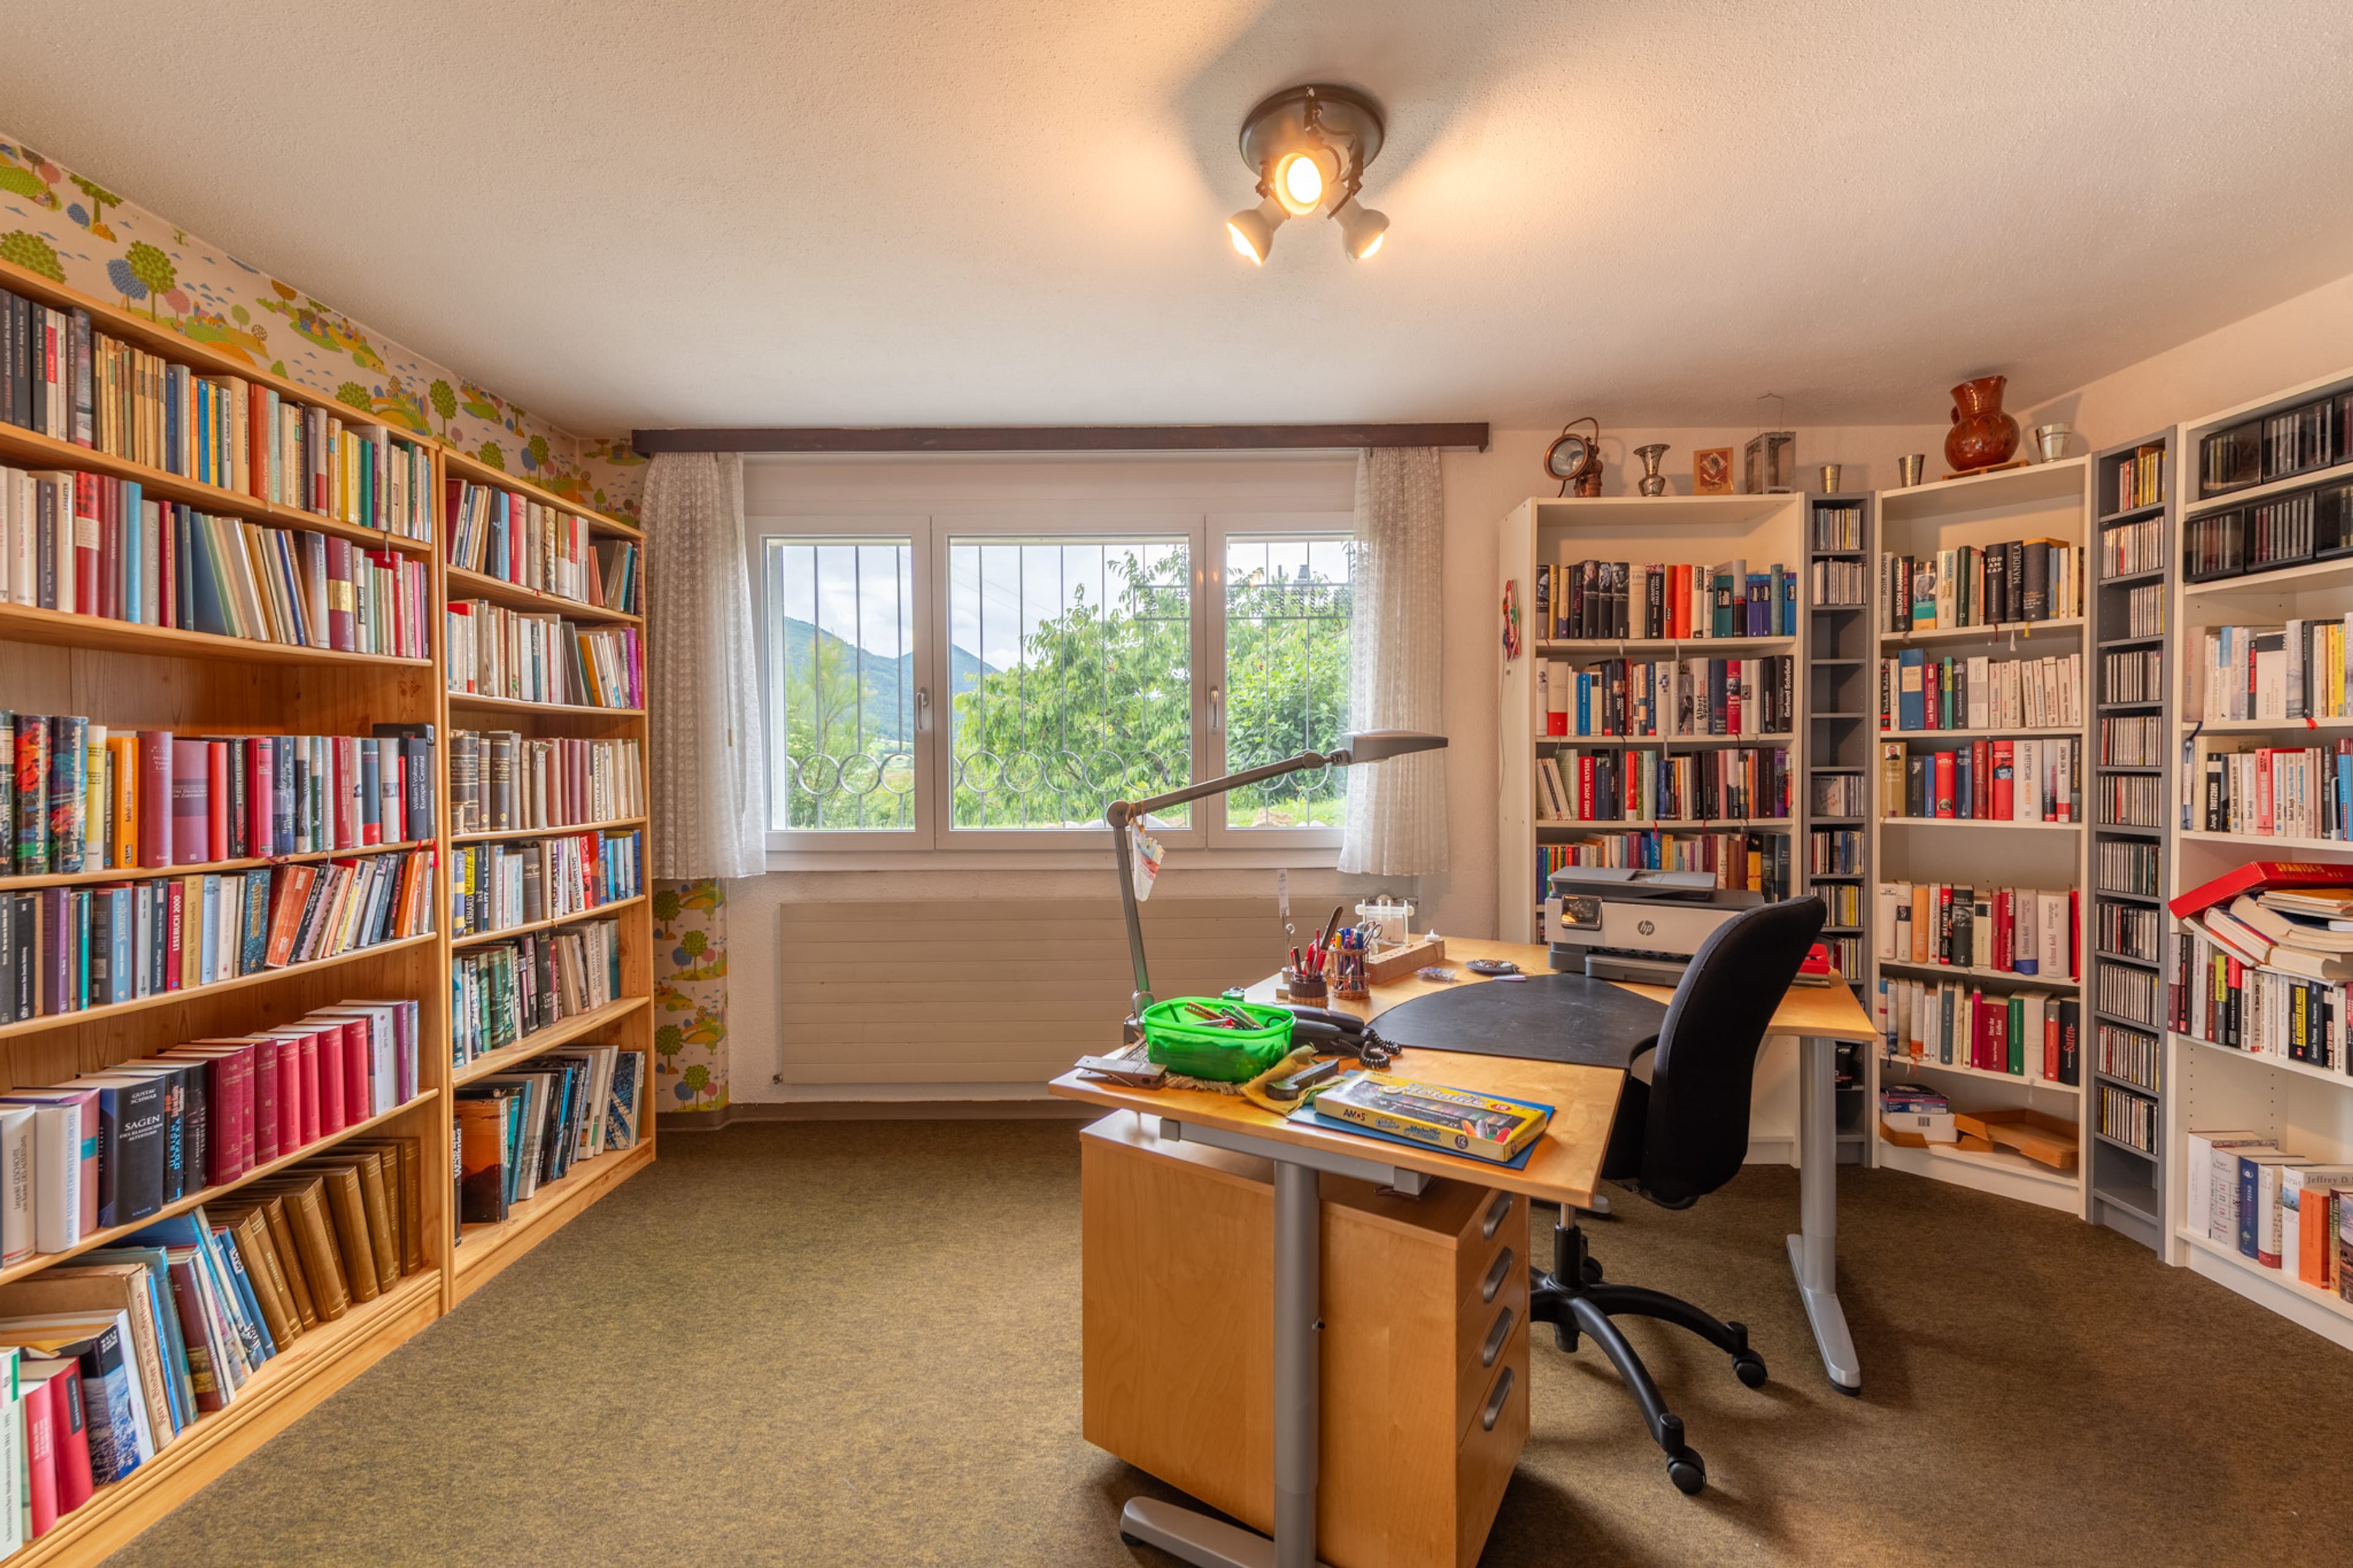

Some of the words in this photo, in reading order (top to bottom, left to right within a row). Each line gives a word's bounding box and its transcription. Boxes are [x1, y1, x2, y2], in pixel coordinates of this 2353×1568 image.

[2275, 863, 2324, 873] SPANISCH
[1640, 921, 1653, 934] hp
[131, 1094, 157, 1105] SCHWAB
[124, 1115, 160, 1131] SAGEN
[267, 1251, 284, 1293] WELTPANORAMA
